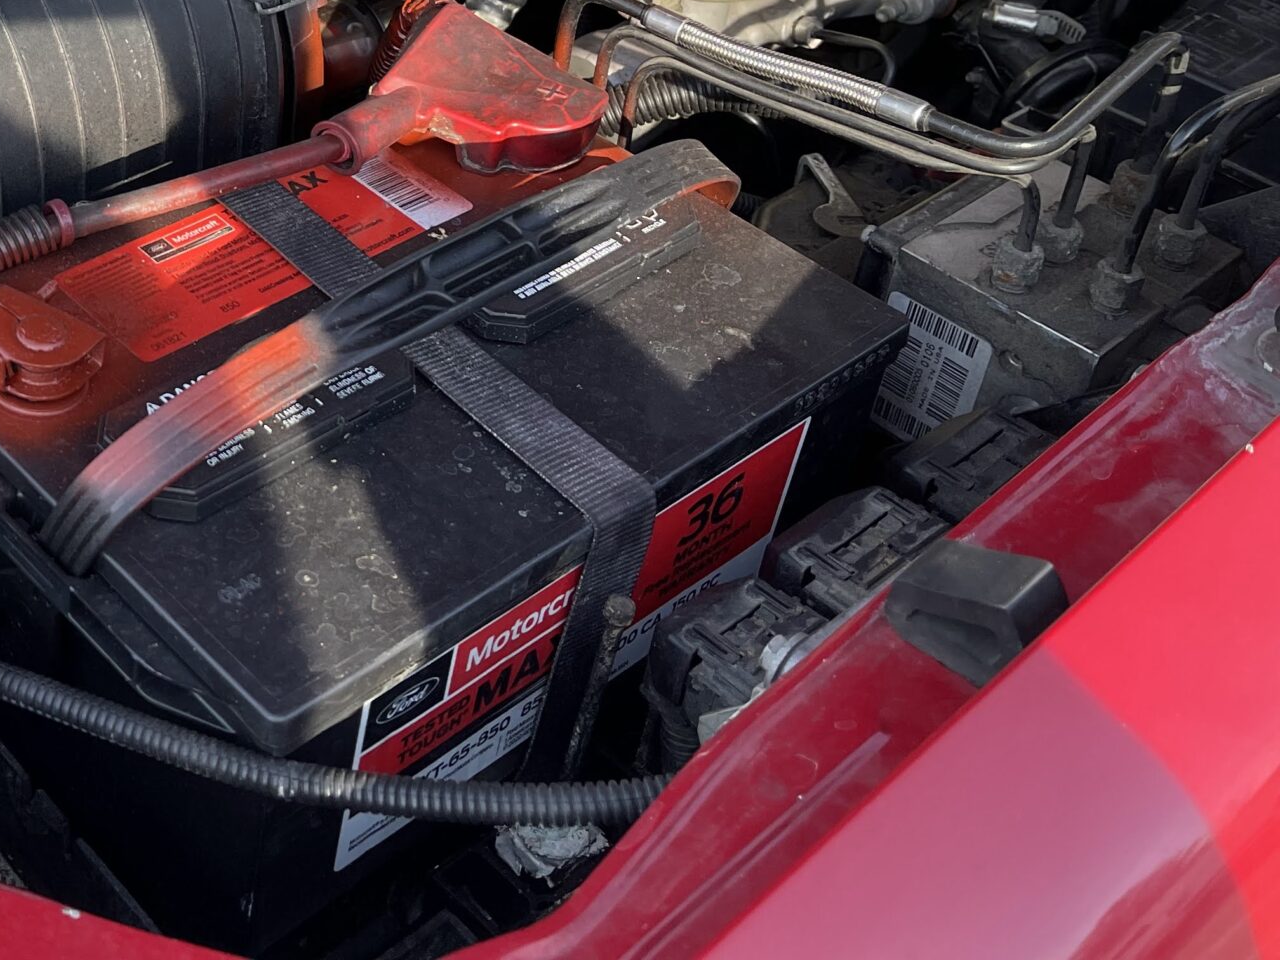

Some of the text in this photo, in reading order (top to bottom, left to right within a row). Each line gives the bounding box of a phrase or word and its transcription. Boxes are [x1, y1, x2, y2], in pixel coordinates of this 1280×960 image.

[172, 218, 219, 244] Motorcraft
[220, 301, 240, 314] 850
[328, 370, 367, 393] BLINDNESS
[336, 382, 363, 399] SEVERE
[918, 346, 945, 409] MADE IN USA
[206, 442, 244, 467] OR INJURY
[676, 472, 745, 548] 36
[673, 519, 733, 563] MONTH
[640, 613, 662, 635] CA
[387, 680, 430, 720] Ford
[401, 697, 470, 745] TESTED
